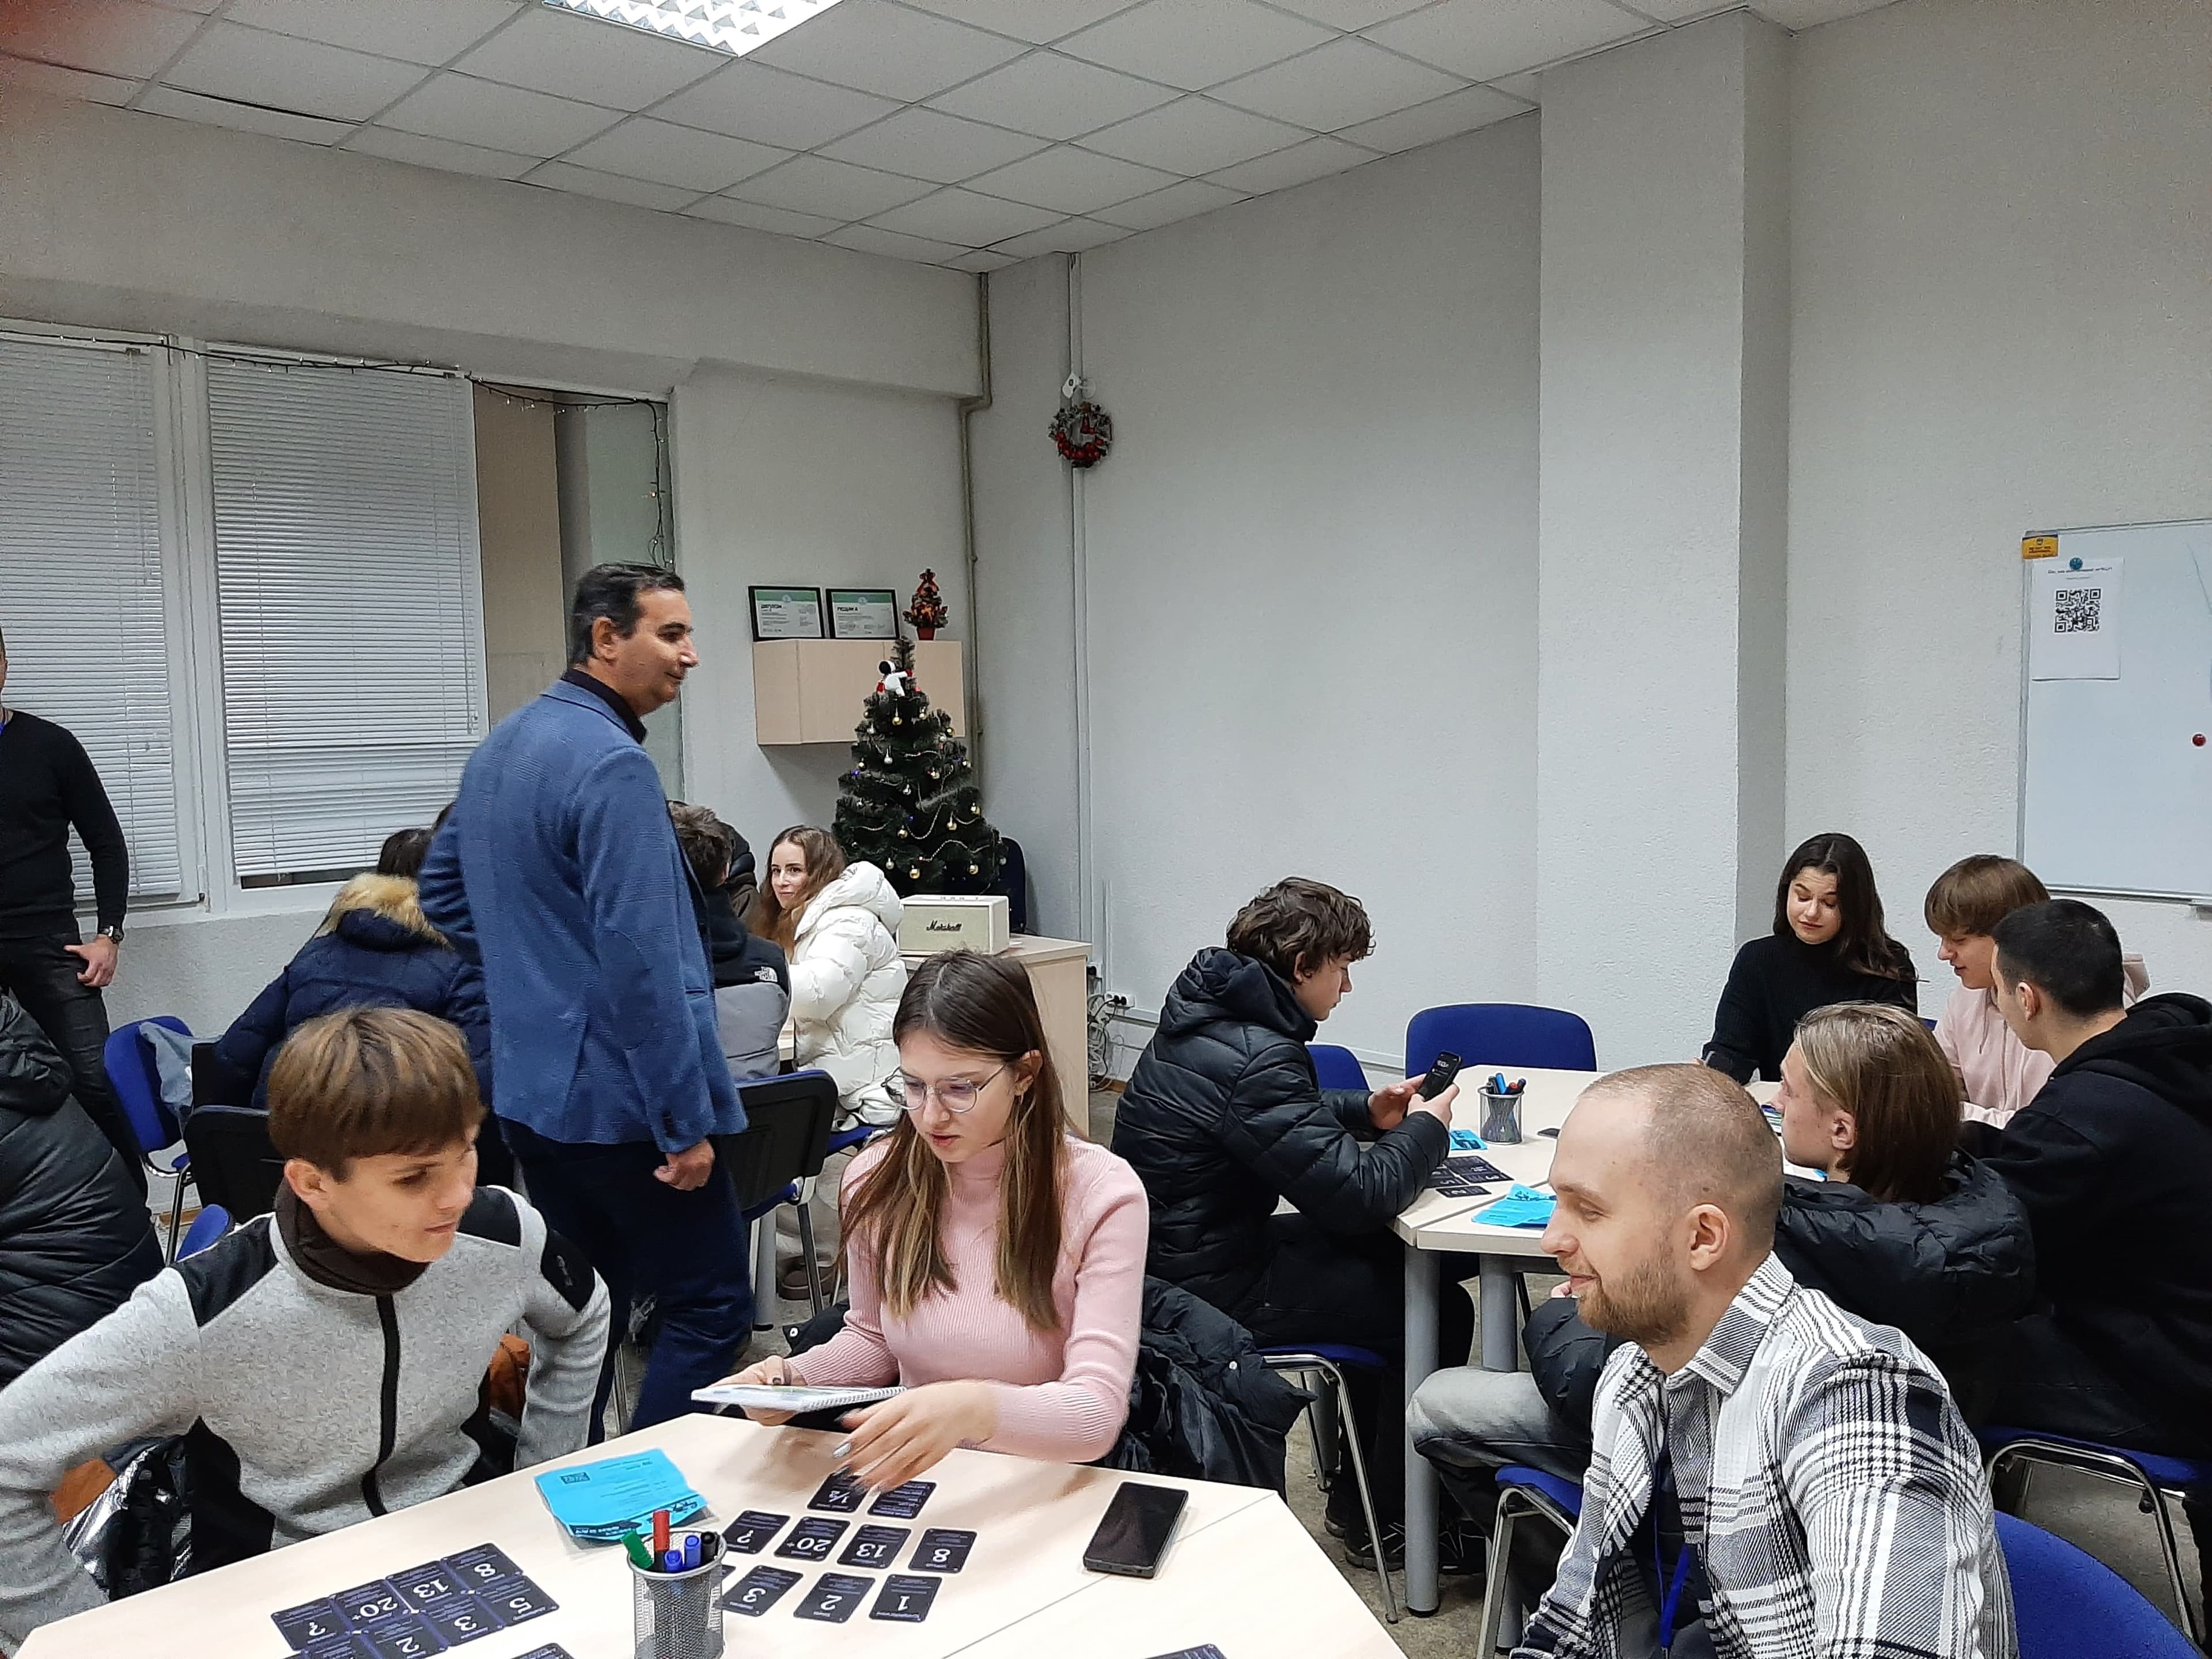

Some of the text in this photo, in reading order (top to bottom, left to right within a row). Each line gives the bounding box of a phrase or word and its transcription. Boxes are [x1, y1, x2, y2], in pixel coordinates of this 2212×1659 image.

[926, 920, 962, 931] Marshall
[855, 1543, 887, 1558] 13
[931, 1548, 951, 1563] 8
[473, 1562, 496, 1578] 8
[413, 1578, 449, 1598] 13
[743, 1588, 766, 1603] 3
[508, 1597, 532, 1614] 5
[820, 1594, 842, 1611] 2
[897, 1596, 910, 1611] 1
[453, 1615, 478, 1632] 3
[395, 1636, 421, 1654] 2
